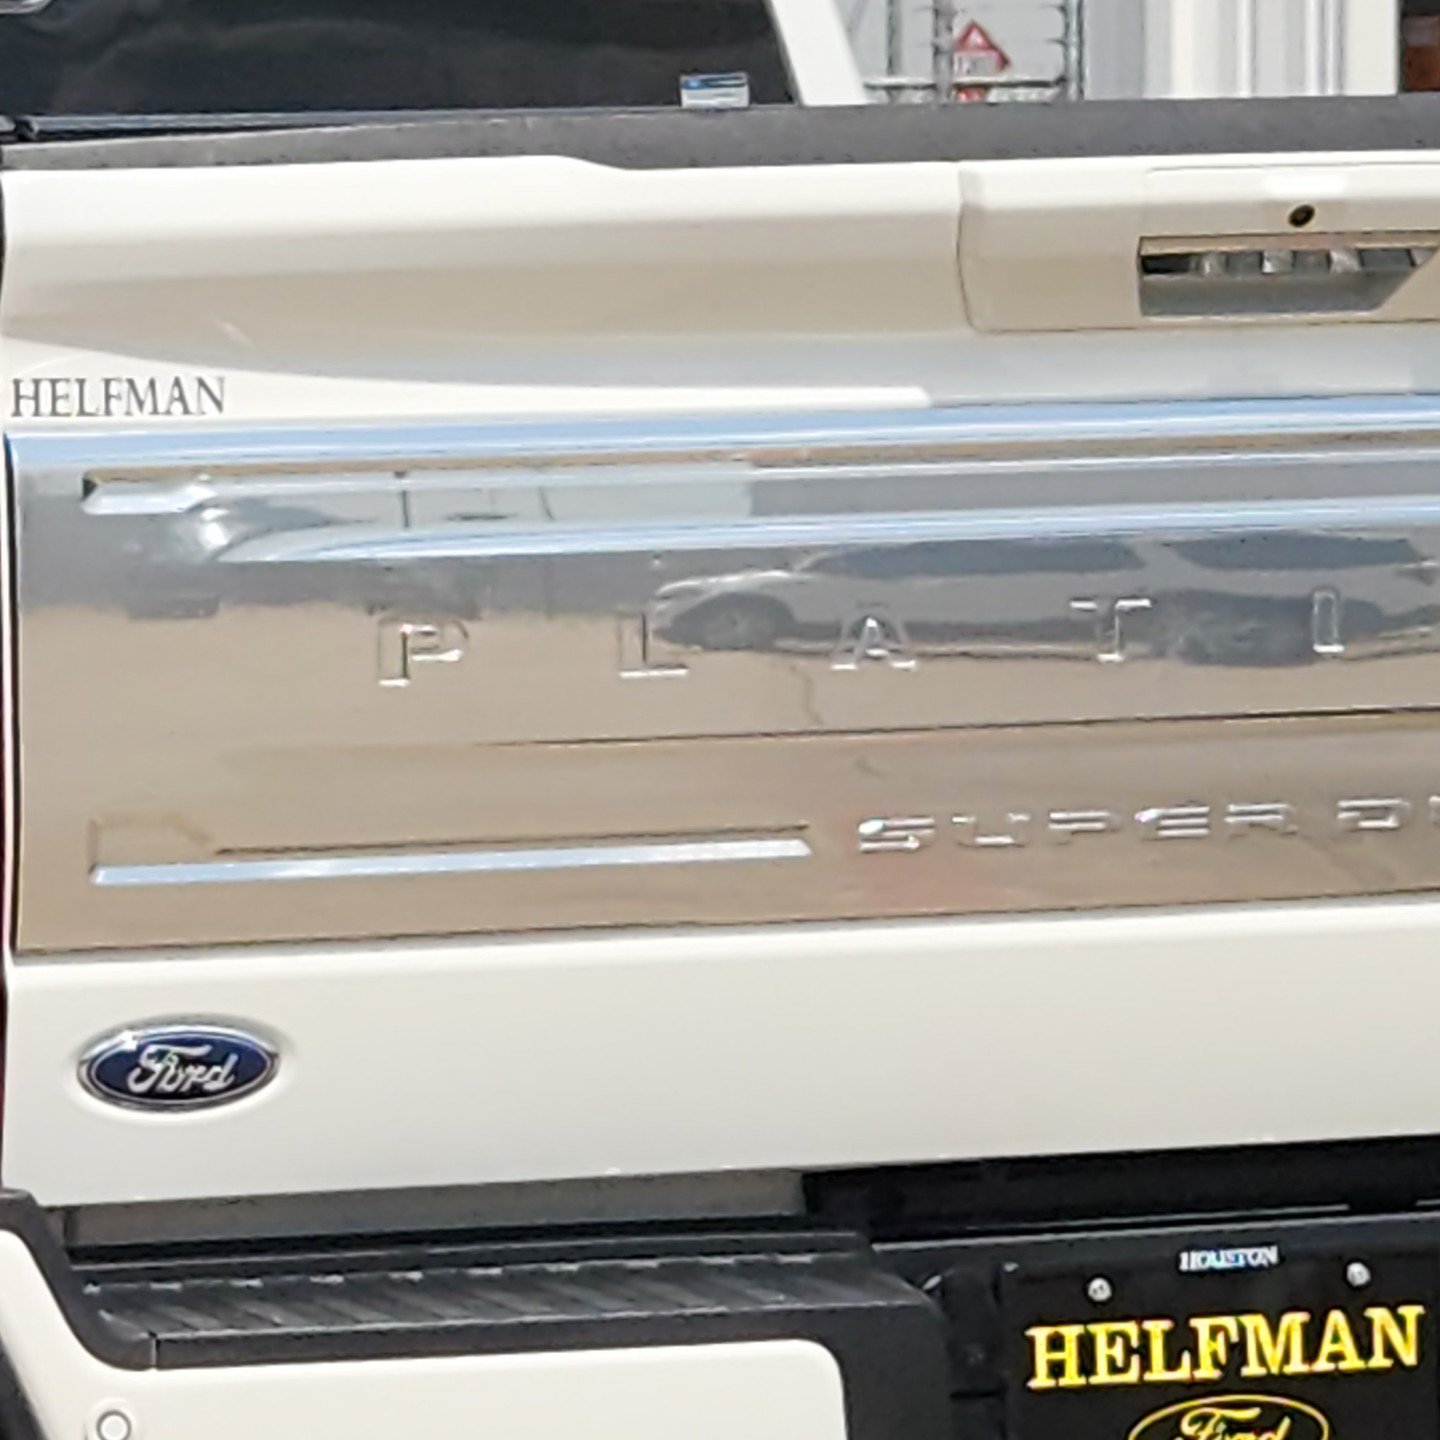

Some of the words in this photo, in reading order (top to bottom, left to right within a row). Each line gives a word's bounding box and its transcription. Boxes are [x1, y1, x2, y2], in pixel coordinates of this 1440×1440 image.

[11, 376, 226, 418] HELFMAN
[858, 802, 1298, 854] SUPER
[126, 1044, 239, 1094] Ford
[1180, 1245, 1278, 1272] HOUSTON
[1025, 1304, 1425, 1390] HELFMAN
